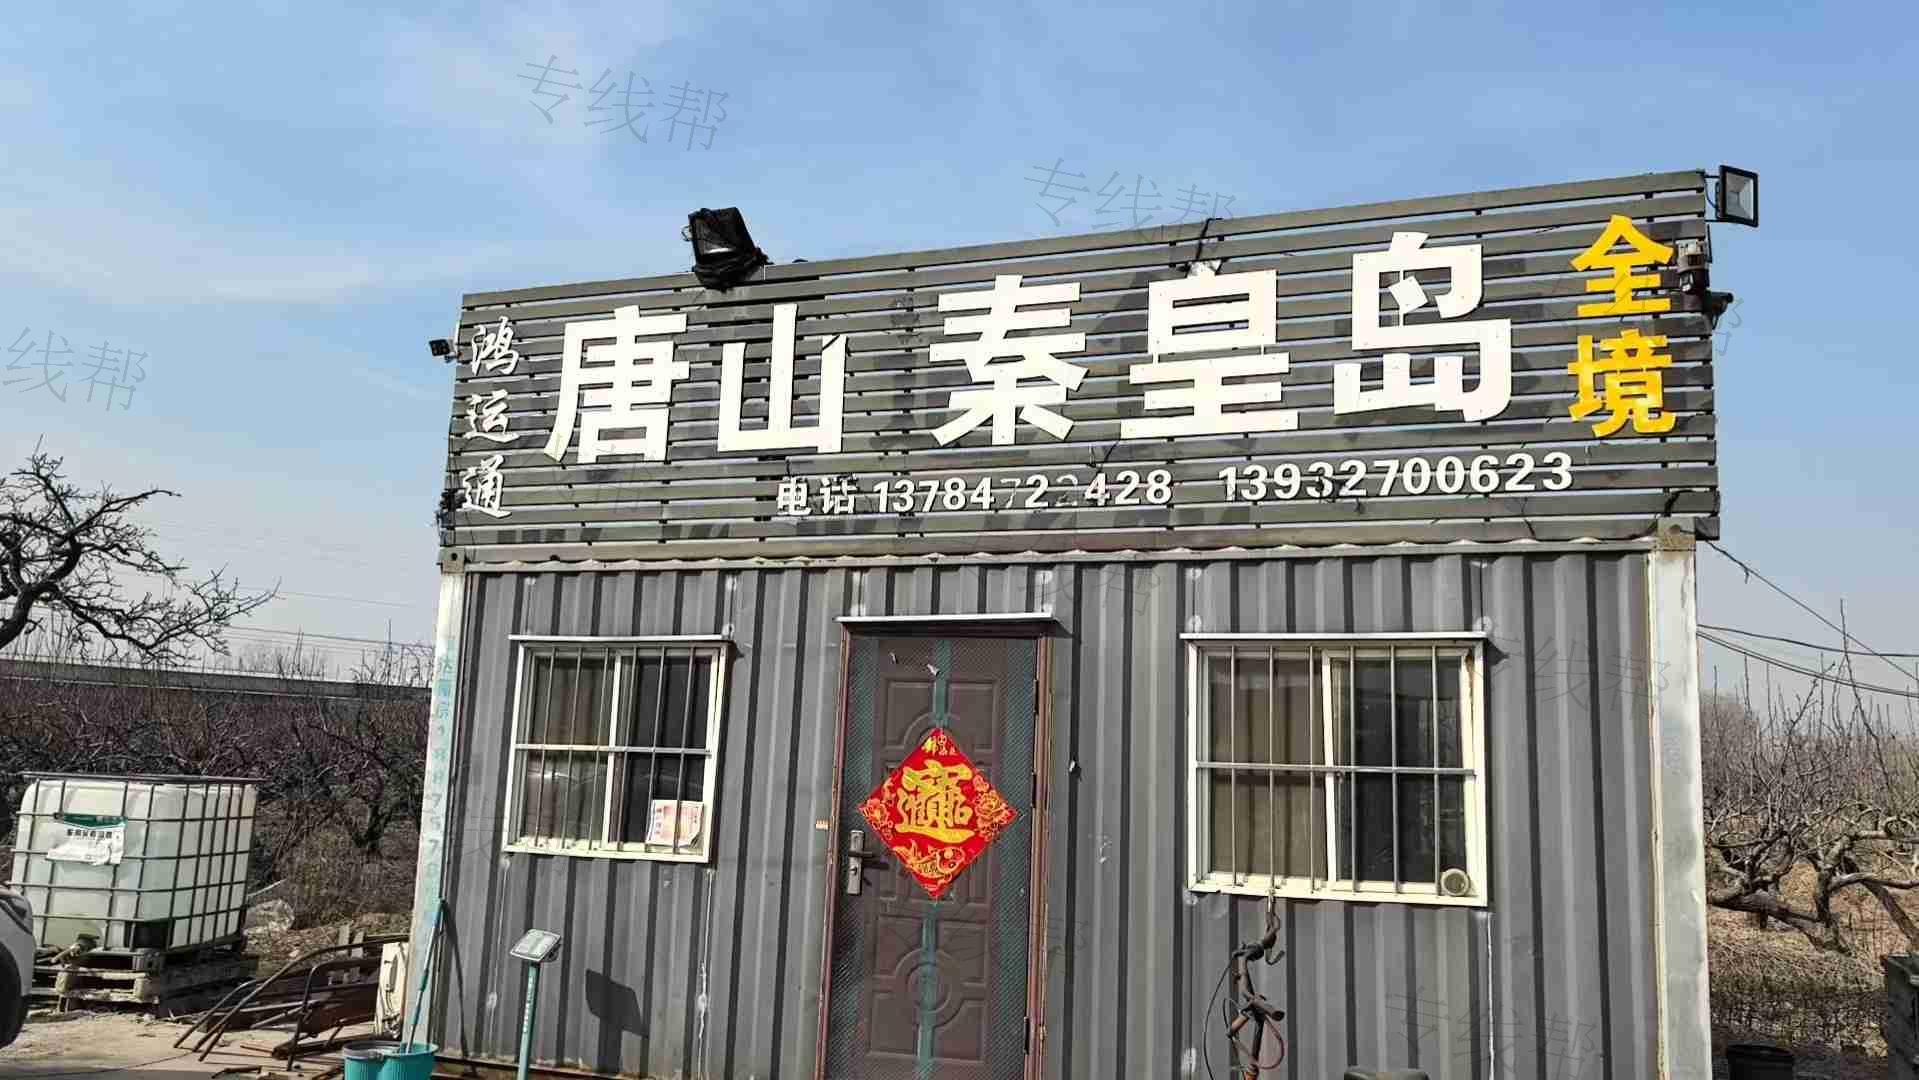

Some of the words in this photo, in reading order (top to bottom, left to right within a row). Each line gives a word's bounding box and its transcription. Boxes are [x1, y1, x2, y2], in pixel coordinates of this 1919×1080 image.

[463, 315, 520, 519] 鸿运通
[1568, 214, 1676, 438] 全境
[1217, 451, 1574, 502] 13932700623
